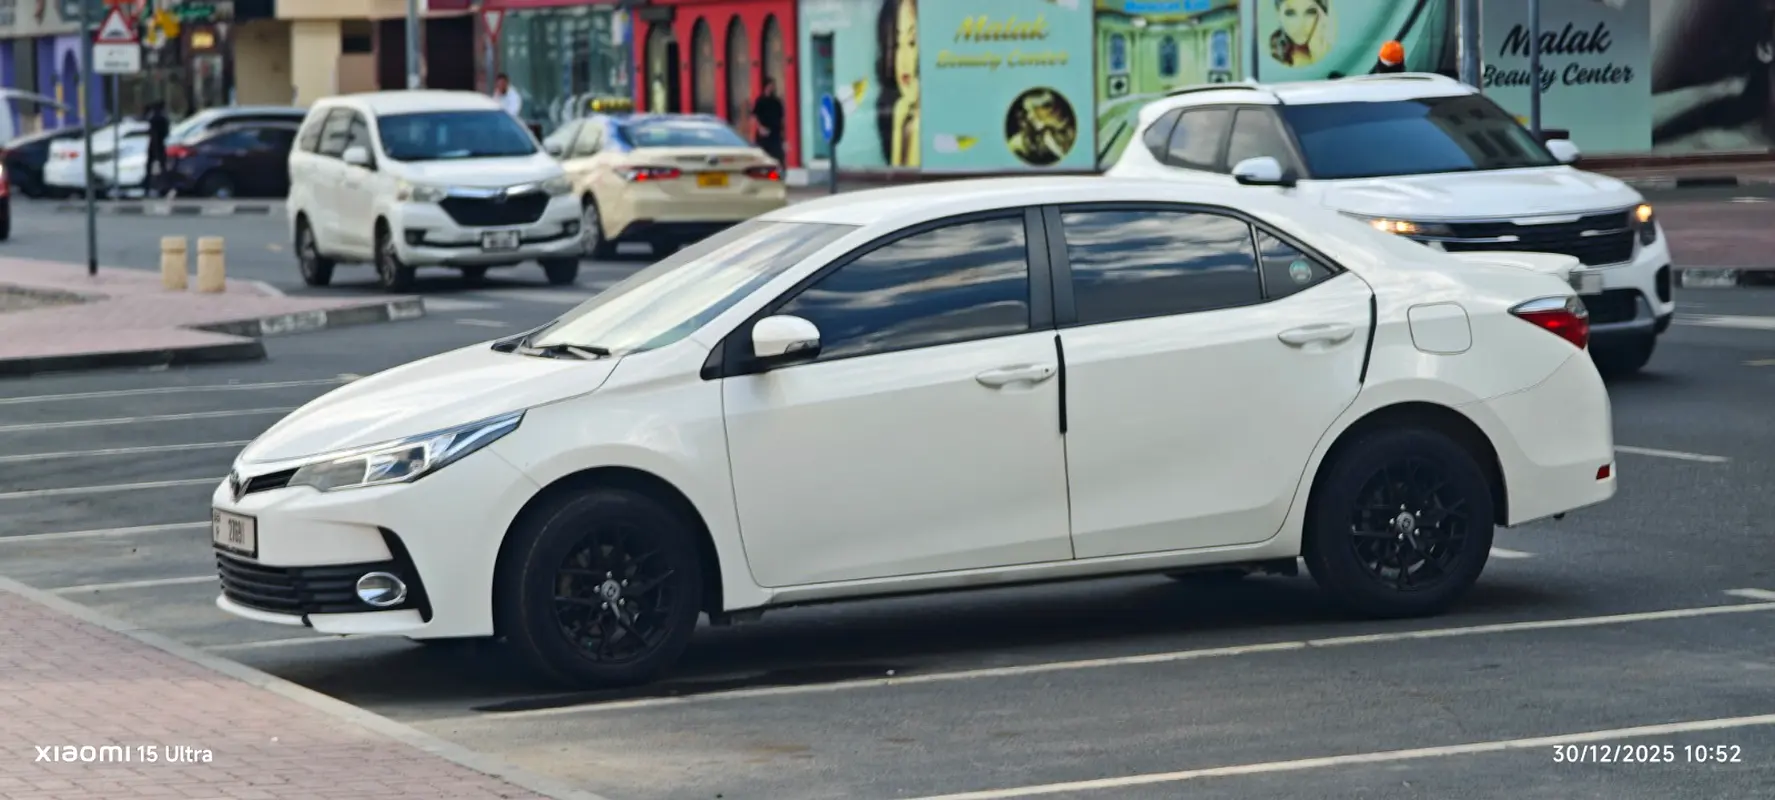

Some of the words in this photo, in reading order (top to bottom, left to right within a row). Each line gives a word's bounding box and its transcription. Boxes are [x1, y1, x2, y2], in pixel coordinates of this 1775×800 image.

[953, 13, 1049, 43] Malak
[1499, 21, 1613, 58] Malak
[1562, 62, 1634, 86] Center
